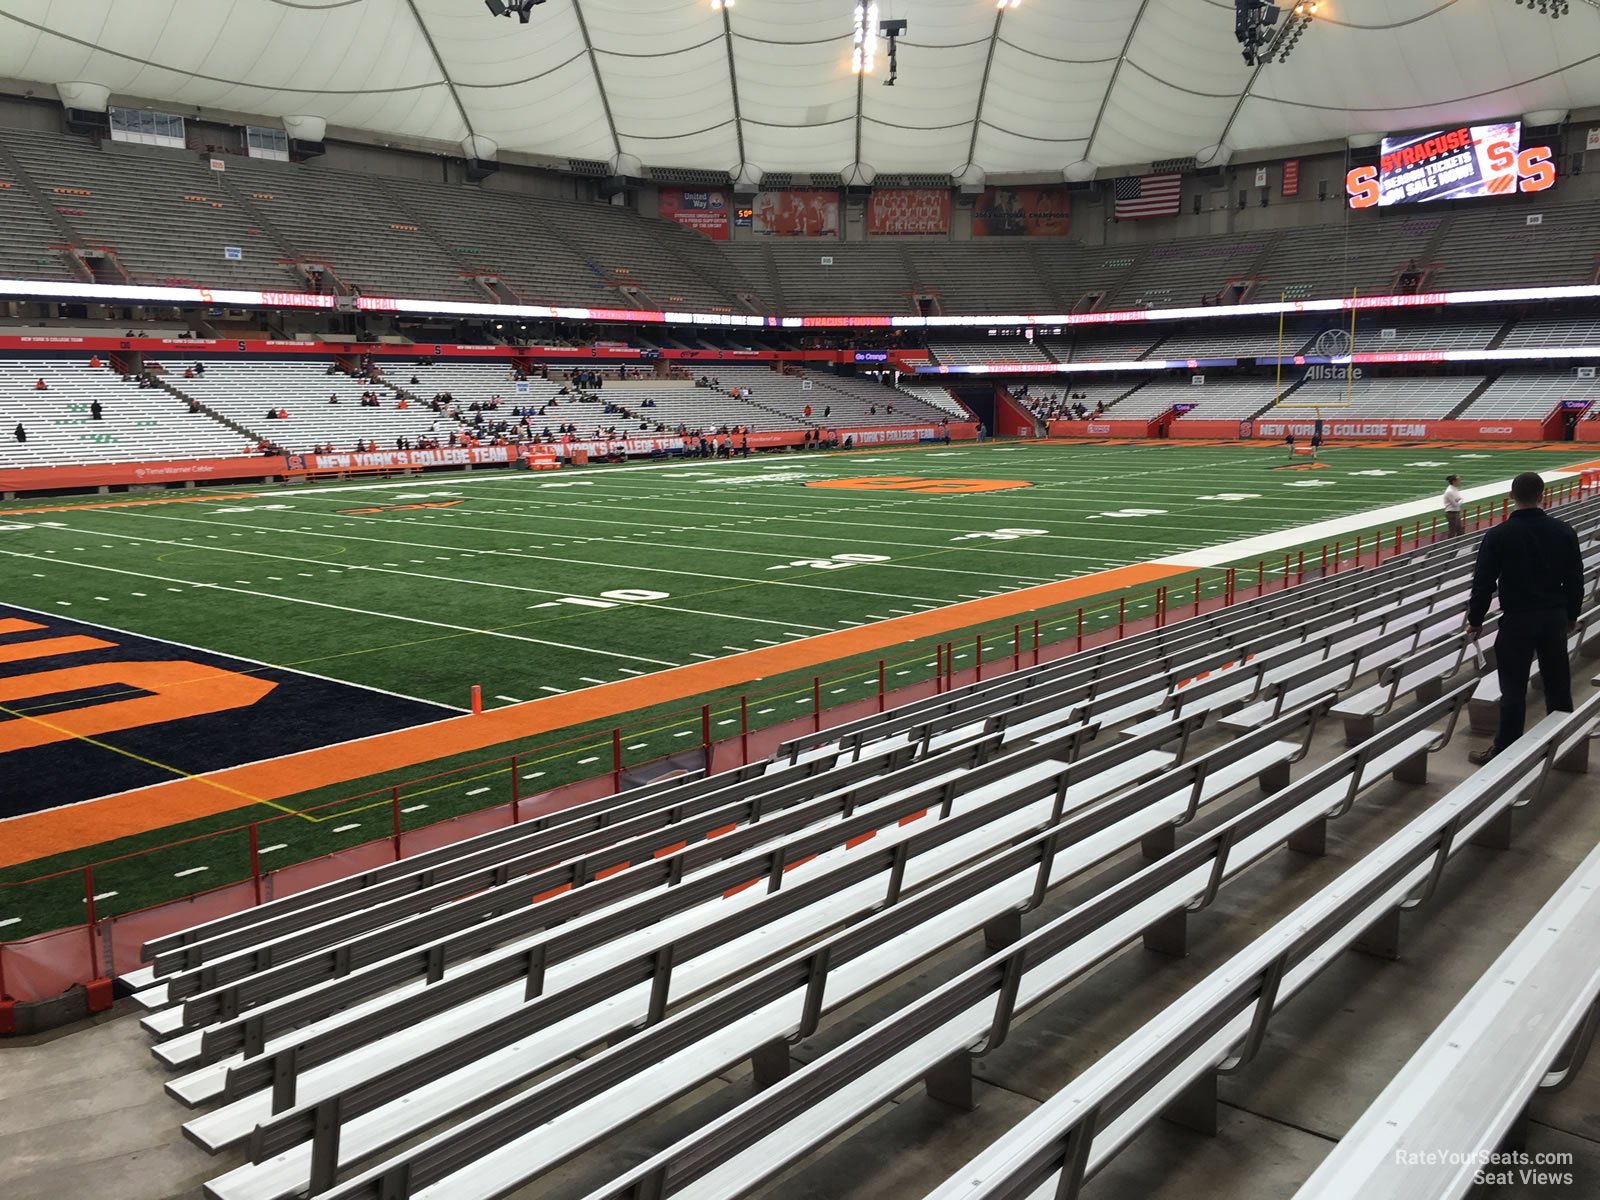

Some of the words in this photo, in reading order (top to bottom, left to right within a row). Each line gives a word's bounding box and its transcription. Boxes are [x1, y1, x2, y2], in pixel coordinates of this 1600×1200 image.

[1381, 128, 1470, 174] SYRACUSE
[1383, 167, 1426, 191] SEASON
[1424, 151, 1473, 176] TICKETS
[1517, 146, 1556, 193] S
[1405, 175, 1438, 197] SALE
[1437, 163, 1475, 186] NOW!
[693, 200, 707, 209] Way
[261, 292, 319, 307] SYRACUSE
[1343, 295, 1394, 309] SYRACUSE
[1396, 293, 1446, 306] FOOTBALL
[804, 317, 849, 327] SYRACUSE
[1303, 366, 1363, 380] Allstate
[859, 431, 886, 443] YORK'S
[886, 429, 916, 441] COLLEGE
[916, 428, 935, 439] TEAM
[1259, 424, 1285, 436] NEW
[1287, 424, 1330, 436] YORS
[1333, 424, 1388, 436] COLLEGE
[1391, 424, 1426, 437] TEAM
[567, 441, 608, 457] YORK'S
[609, 439, 655, 455] COLLEGE
[657, 437, 686, 451] TEAM
[315, 454, 350, 468] NEW
[352, 452, 409, 467] YORK'S
[411, 448, 470, 466] COLLEGE
[472, 446, 508, 464] TEAM
[191, 465, 214, 473] Cable
[789, 553, 892, 570] 20
[555, 588, 671, 609] 10
